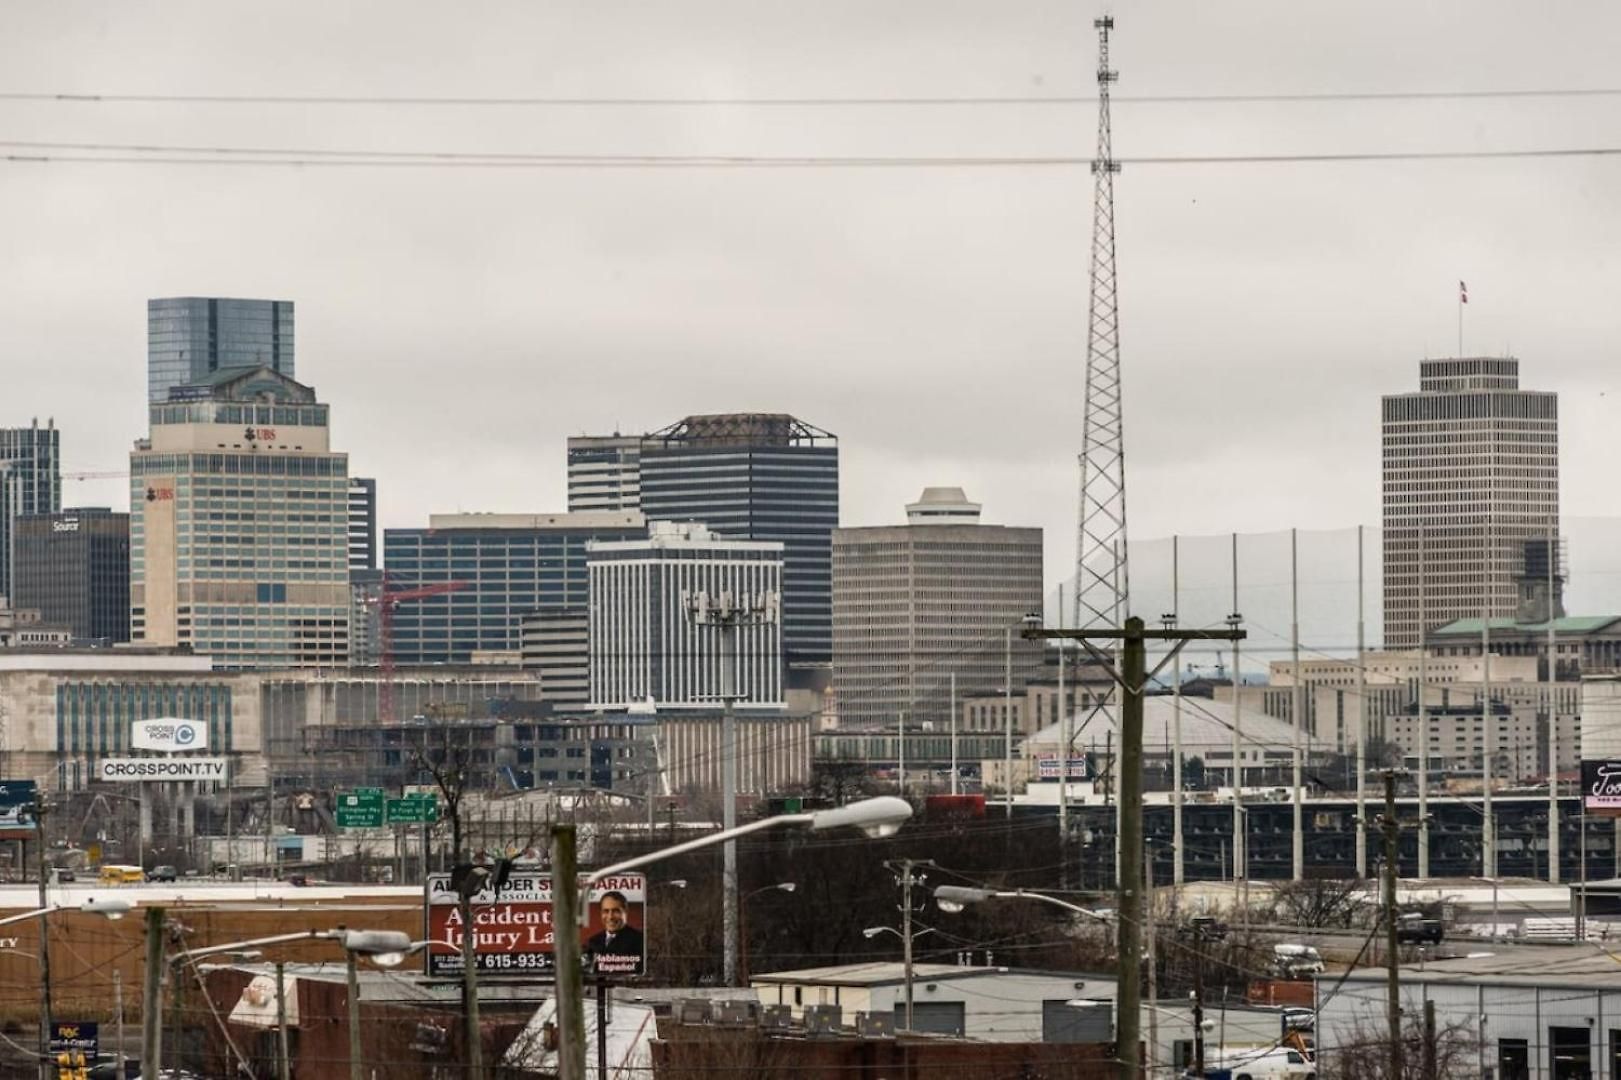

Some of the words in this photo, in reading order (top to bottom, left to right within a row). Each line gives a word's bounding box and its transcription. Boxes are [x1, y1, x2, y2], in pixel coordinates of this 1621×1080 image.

[256, 428, 276, 441] UBS
[104, 763, 223, 775] CROSSPOINT.TV
[445, 927, 521, 950] Ijury
[528, 926, 554, 944] La
